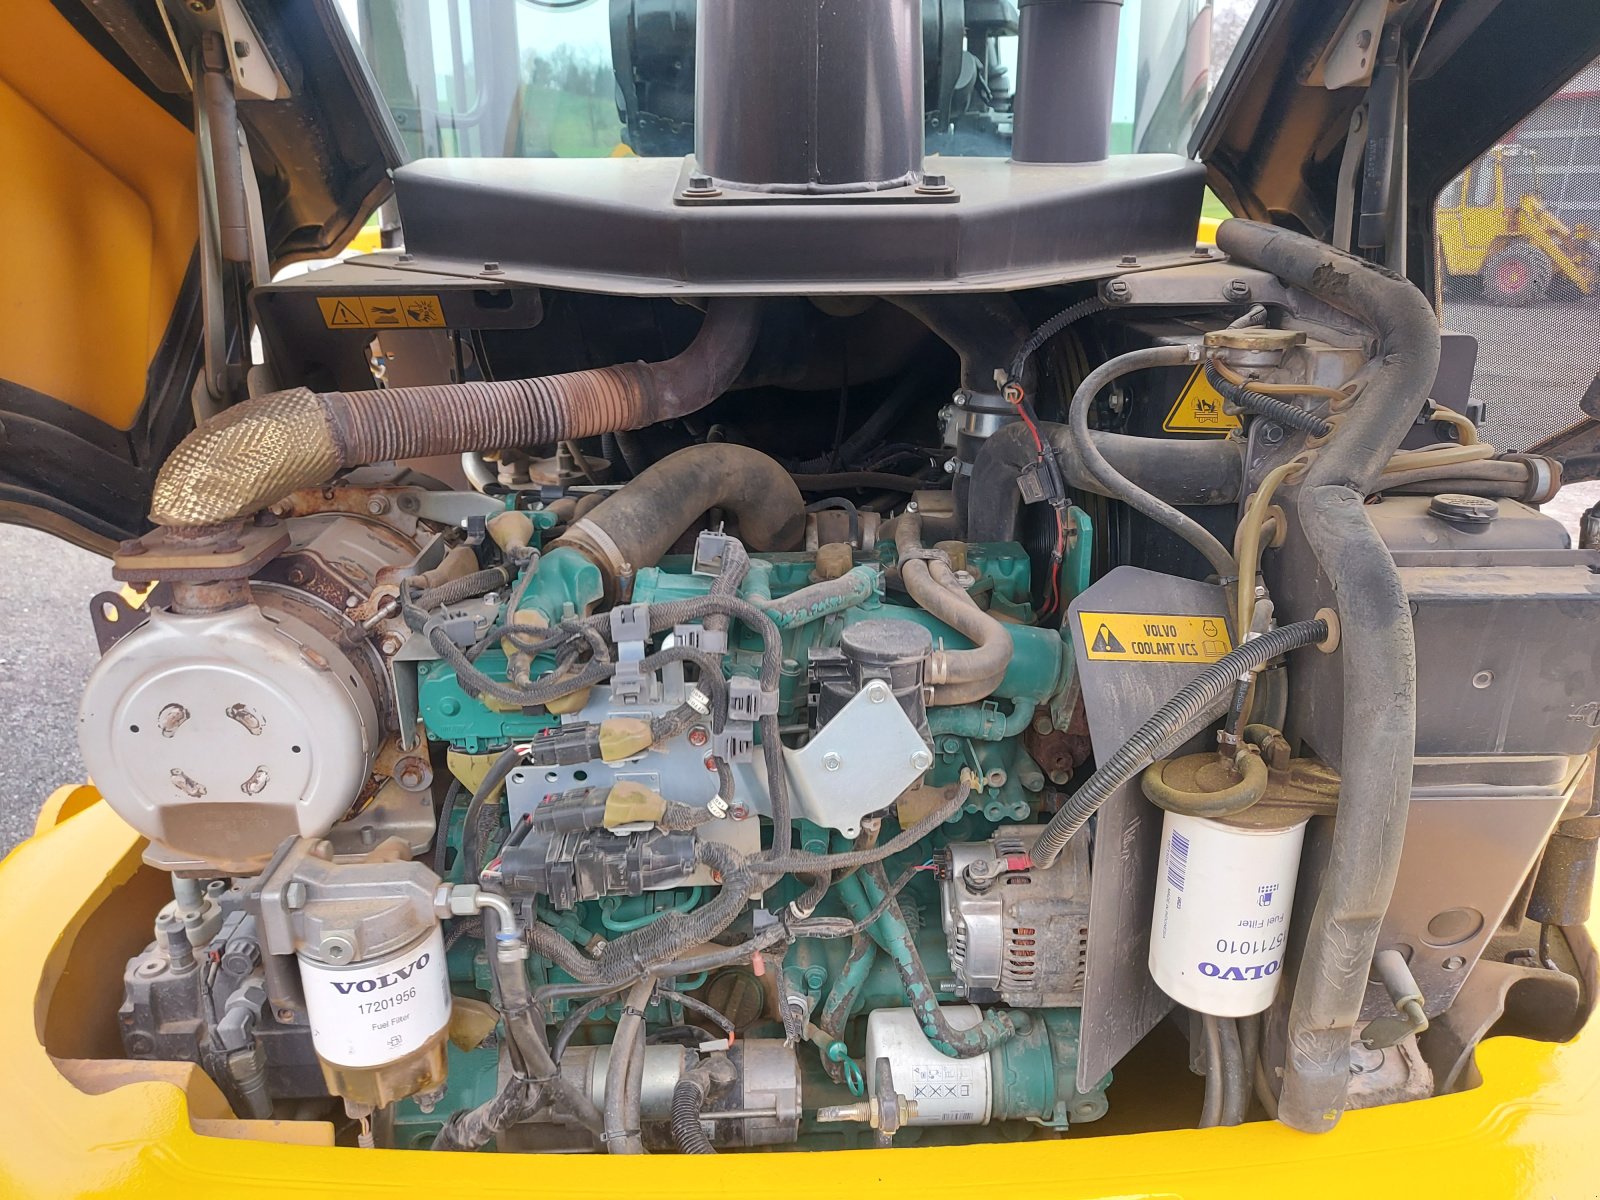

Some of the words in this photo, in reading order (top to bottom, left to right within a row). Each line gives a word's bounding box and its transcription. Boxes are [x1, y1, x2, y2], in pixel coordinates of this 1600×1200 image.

[1143, 624, 1178, 638] VOLVO
[1131, 641, 1175, 656] COOLANT
[1177, 643, 1199, 656] VCS
[1237, 919, 1264, 928] Filter
[1267, 913, 1285, 927] Fuel
[330, 953, 430, 994] VOLVO
[358, 986, 416, 1015] 17201956
[372, 1020, 389, 1031] Fuel
[391, 1013, 410, 1026] Filter
